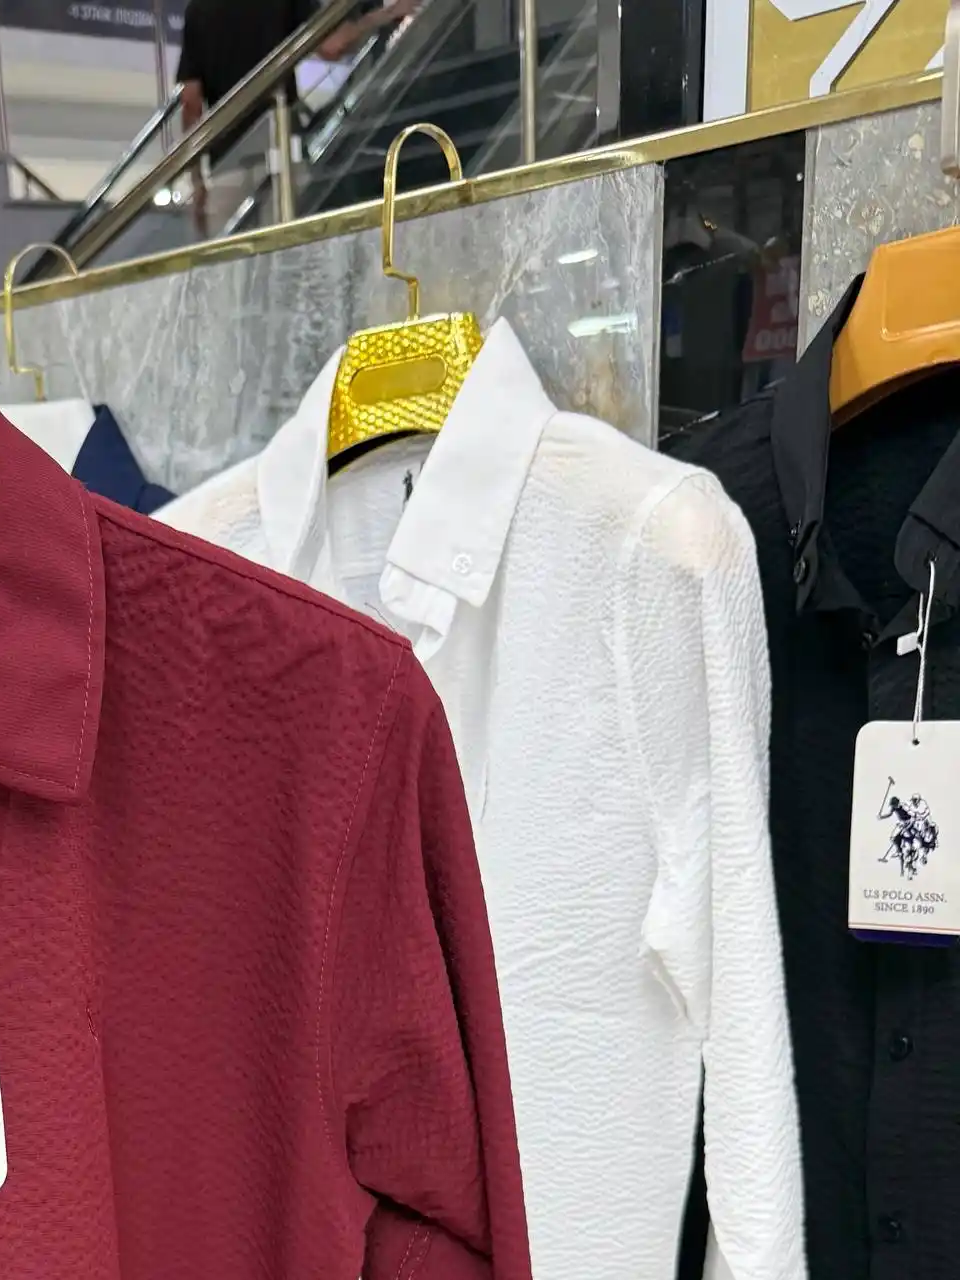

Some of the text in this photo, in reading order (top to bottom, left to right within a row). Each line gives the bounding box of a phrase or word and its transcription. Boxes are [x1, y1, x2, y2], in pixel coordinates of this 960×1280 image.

[882, 890, 913, 901] POLO
[915, 892, 948, 903] ASSN.
[874, 902, 935, 915] SINCE 1890
